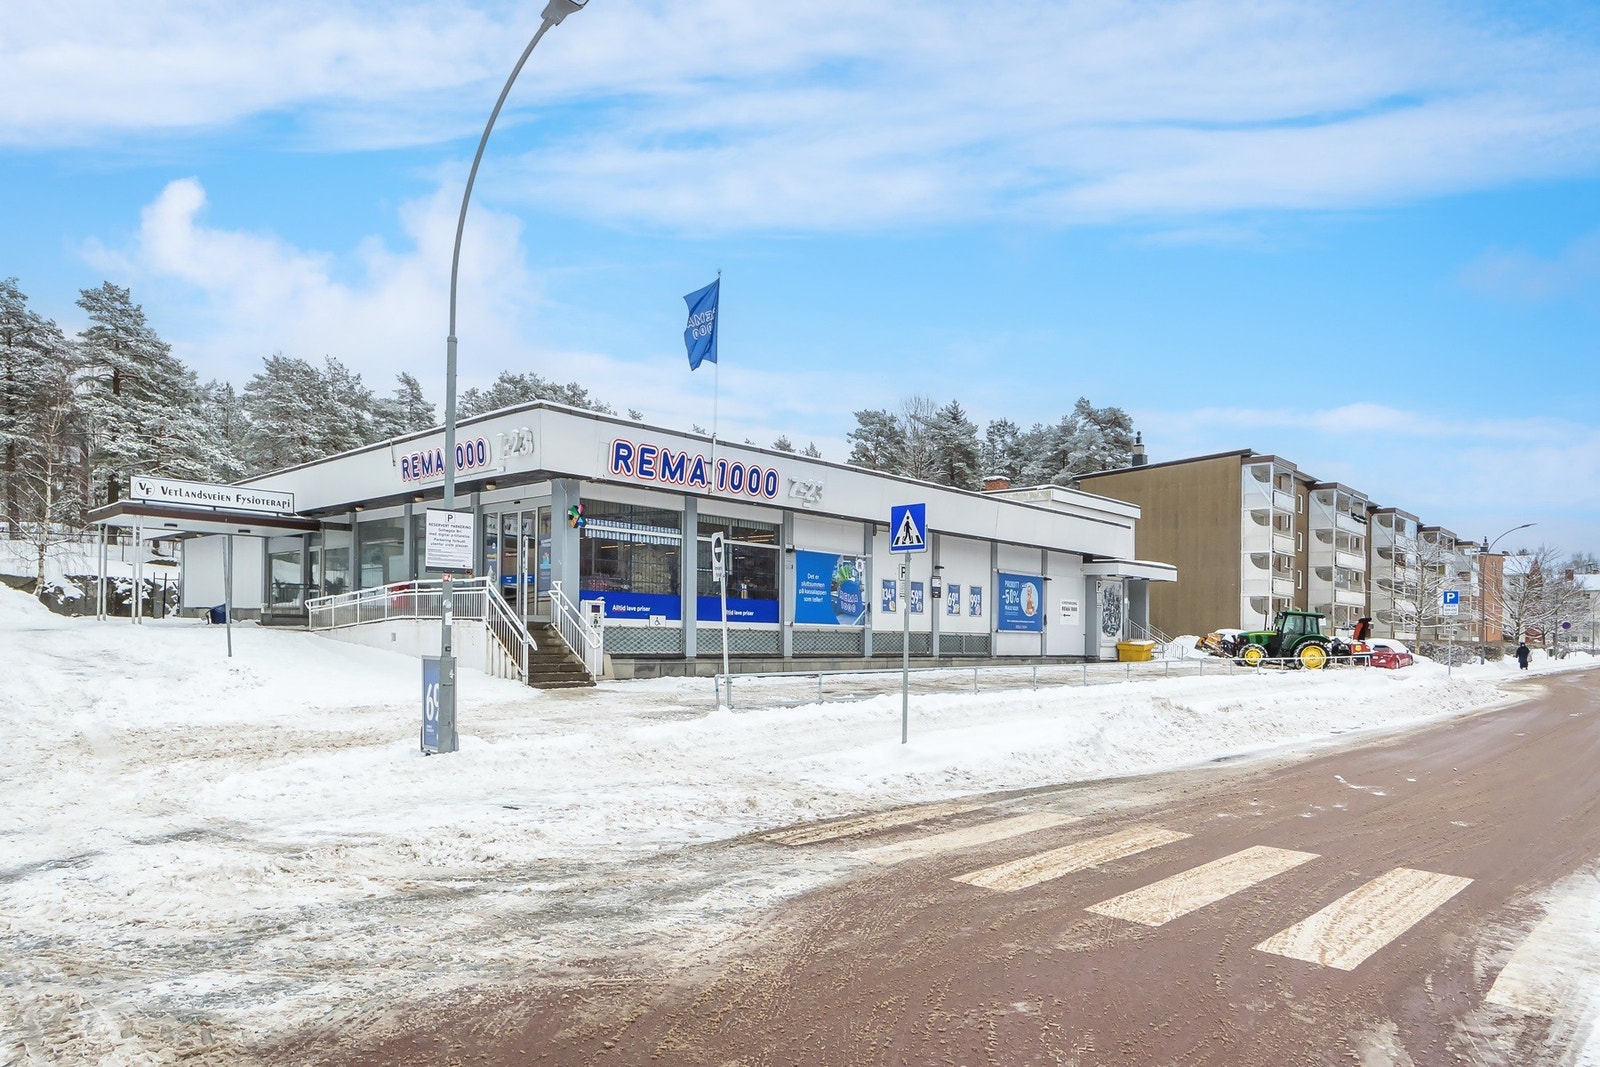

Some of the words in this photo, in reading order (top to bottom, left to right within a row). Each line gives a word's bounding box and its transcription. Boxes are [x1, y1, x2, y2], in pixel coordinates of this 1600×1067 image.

[402, 448, 445, 482] REMA
[455, 438, 486, 471] 000
[610, 438, 709, 488] REMA
[716, 458, 780, 500] 1000
[447, 514, 453, 522] P
[839, 590, 858, 603] REMA
[1002, 589, 1020, 604] -50%
[1447, 592, 1455, 603] P
[841, 600, 856, 613] 1000
